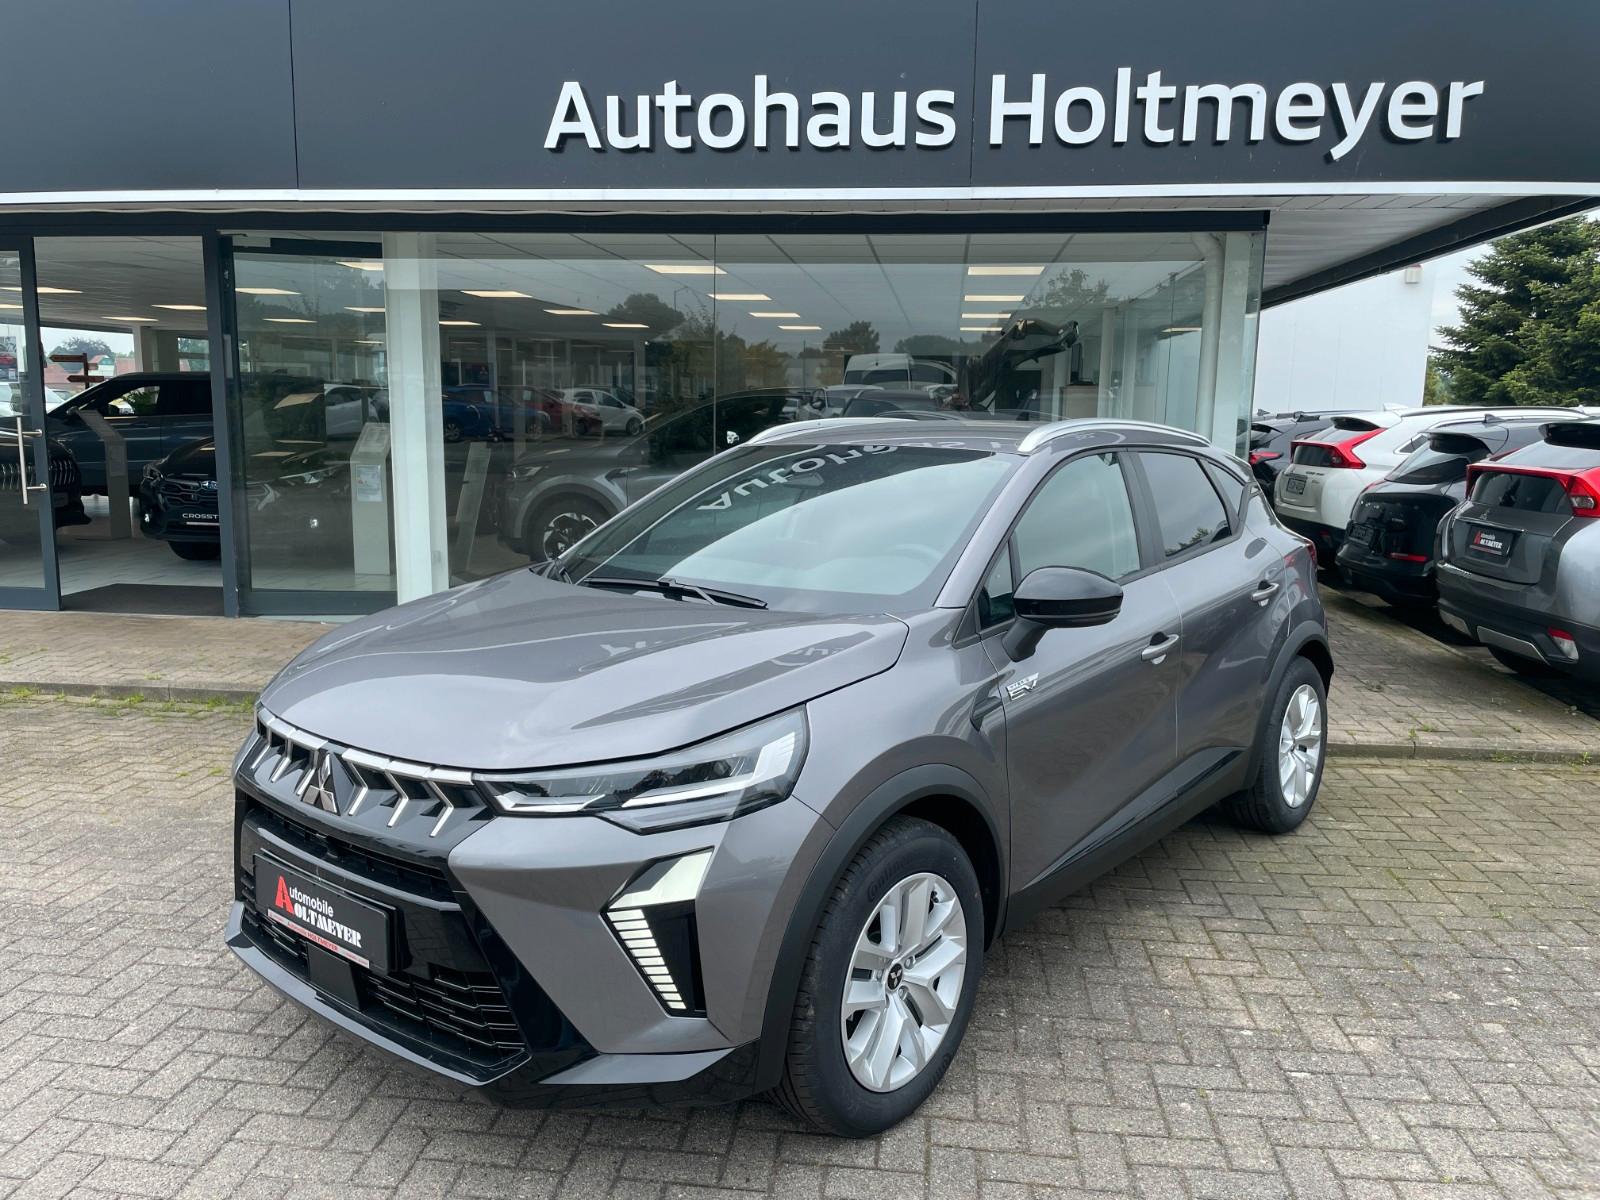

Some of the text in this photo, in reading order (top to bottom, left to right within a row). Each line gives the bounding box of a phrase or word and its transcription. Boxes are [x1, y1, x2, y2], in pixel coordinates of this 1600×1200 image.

[543, 67, 1485, 161] Autohaus Holtmeyer
[275, 875, 334, 917] Automobile
